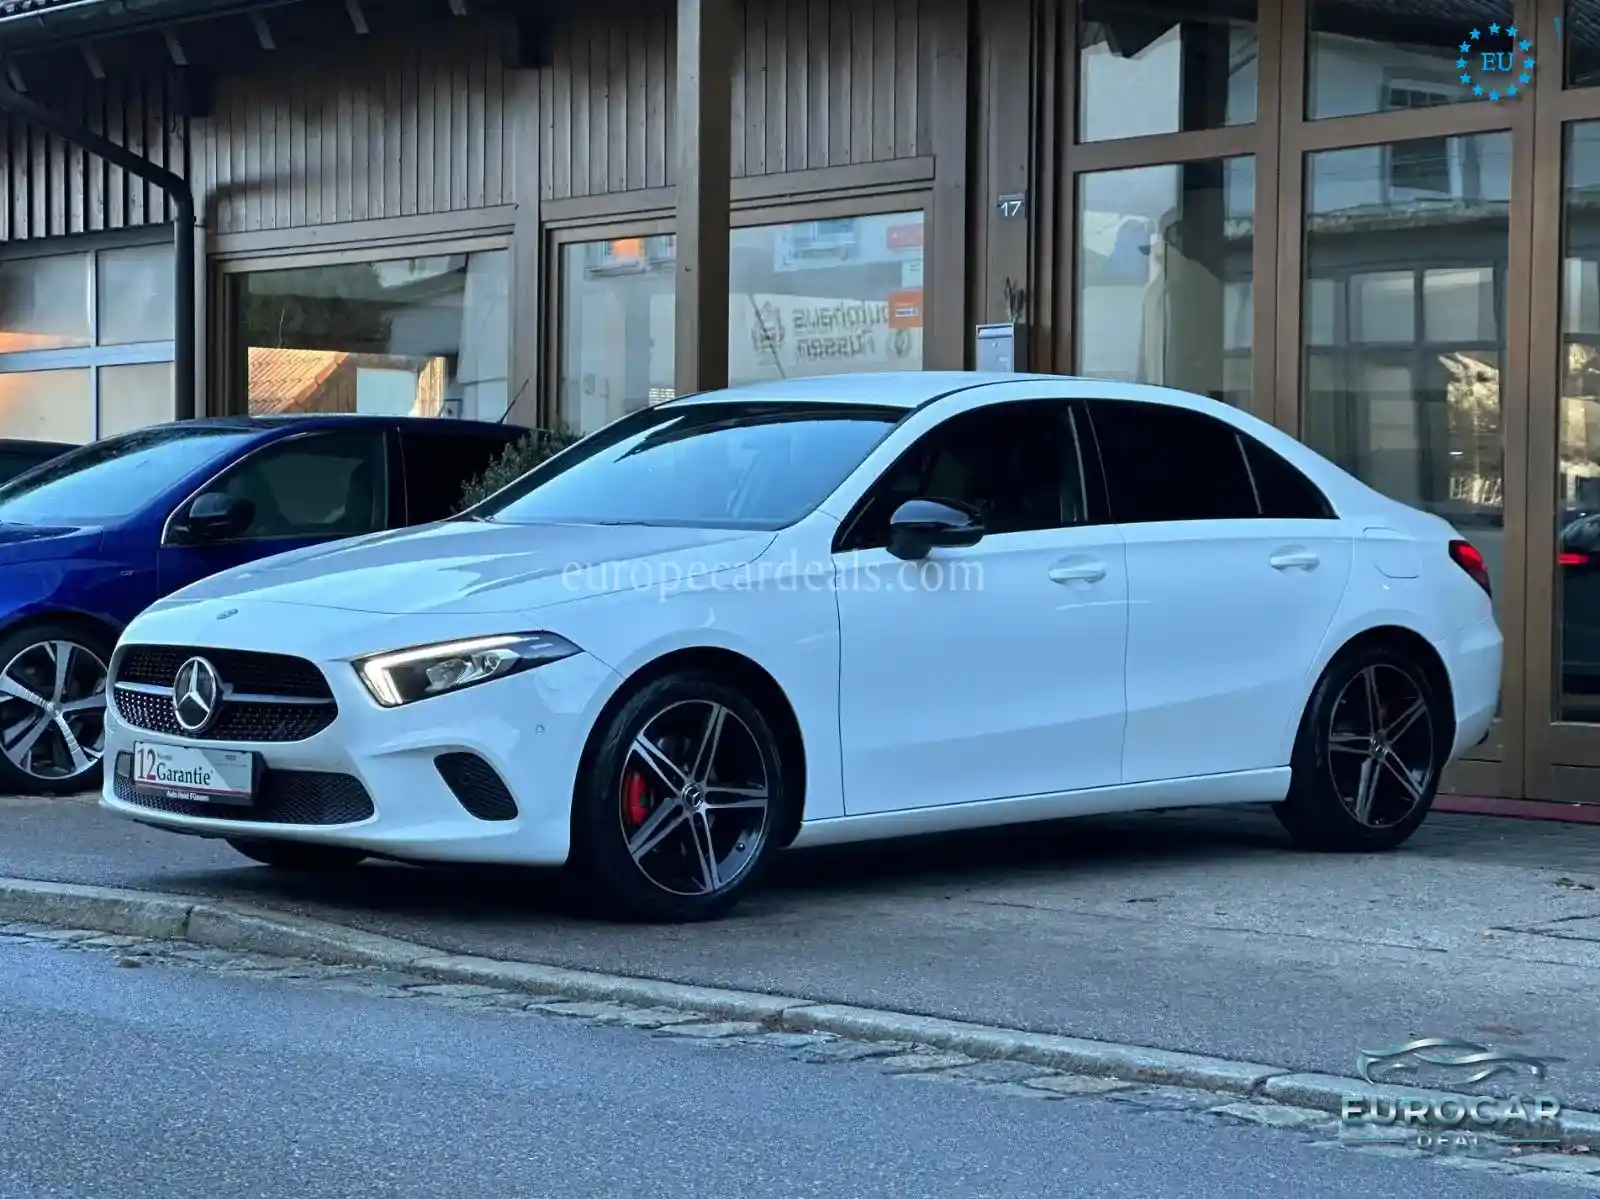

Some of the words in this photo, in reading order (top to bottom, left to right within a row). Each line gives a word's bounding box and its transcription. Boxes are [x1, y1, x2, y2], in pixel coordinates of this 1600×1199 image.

[1000, 200, 1022, 217] 17
[137, 747, 157, 781] 12
[156, 762, 211, 786] Garantie
